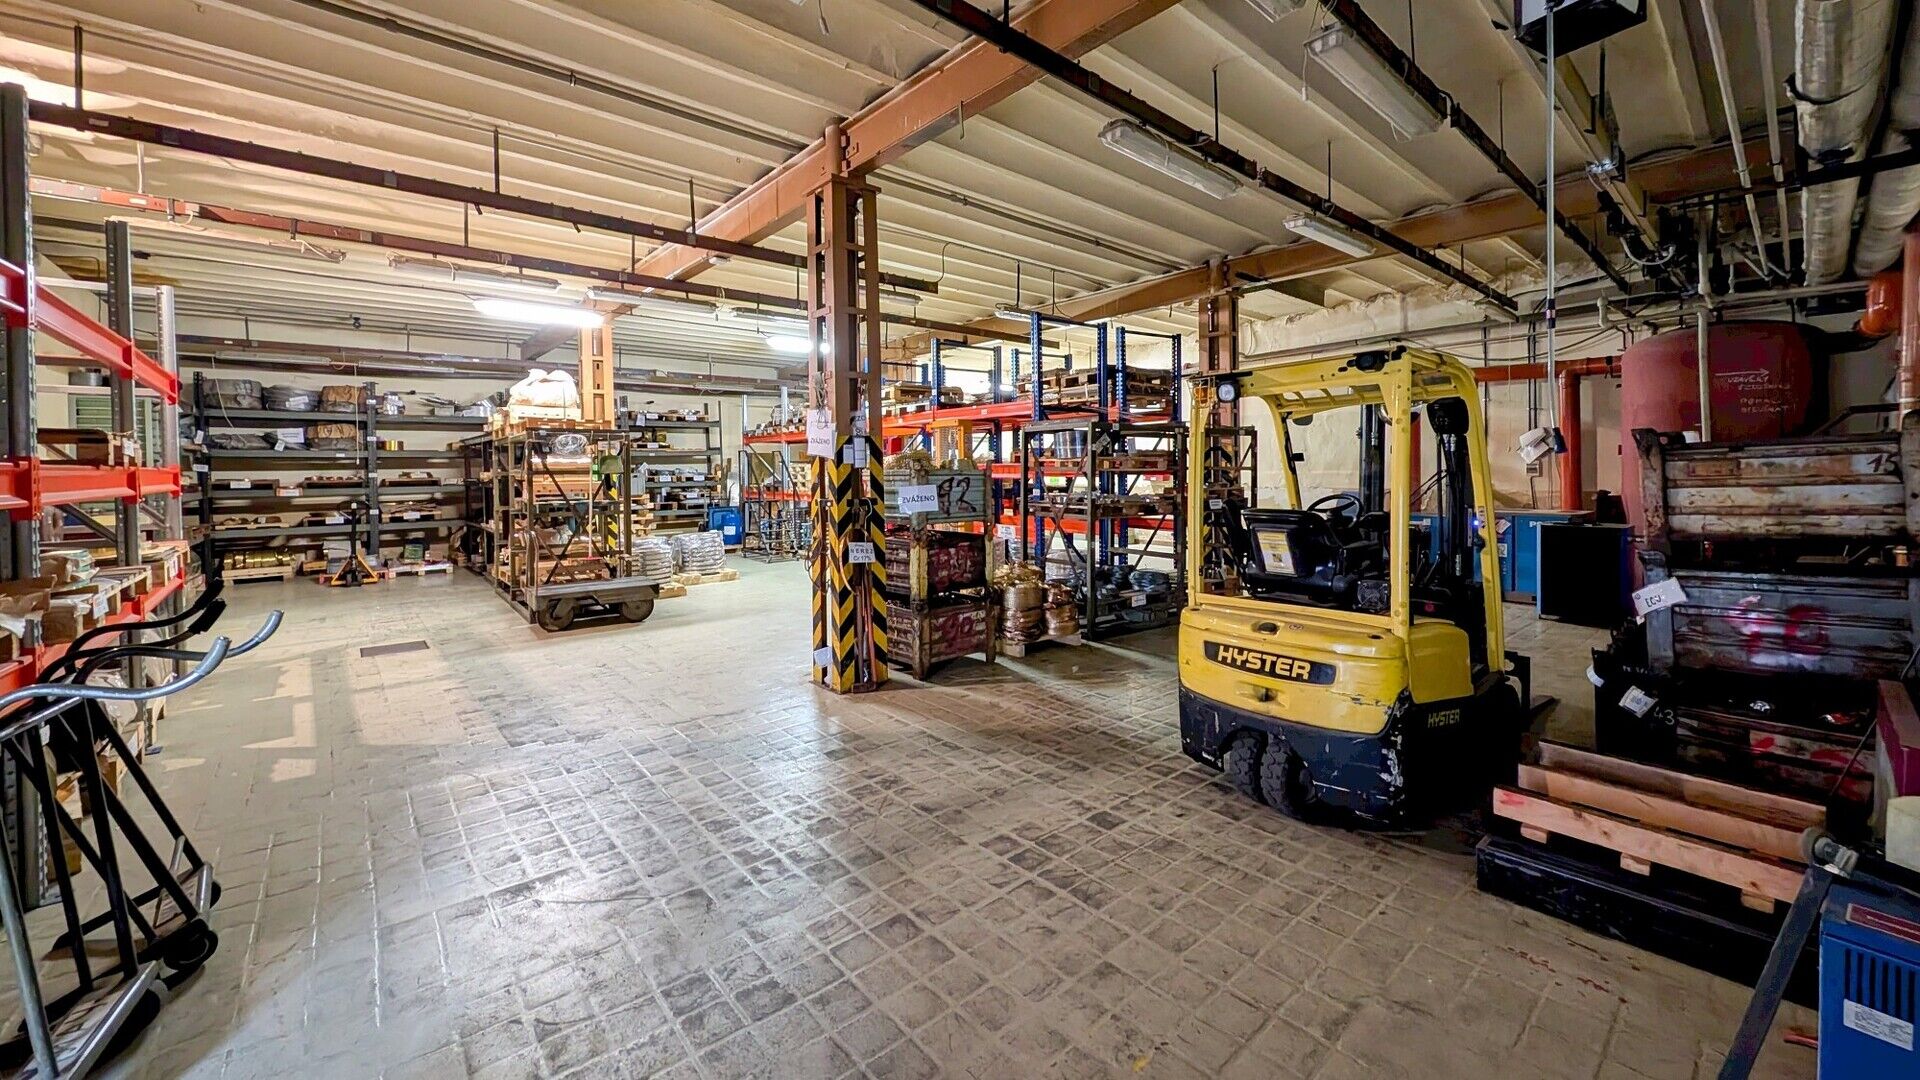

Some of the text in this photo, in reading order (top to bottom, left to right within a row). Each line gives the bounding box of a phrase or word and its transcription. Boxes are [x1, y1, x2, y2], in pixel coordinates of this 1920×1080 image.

[902, 494, 936, 504] ZVÁŽENO
[1217, 645, 1311, 681] HYSTER
[1427, 708, 1461, 729] HYSTER
